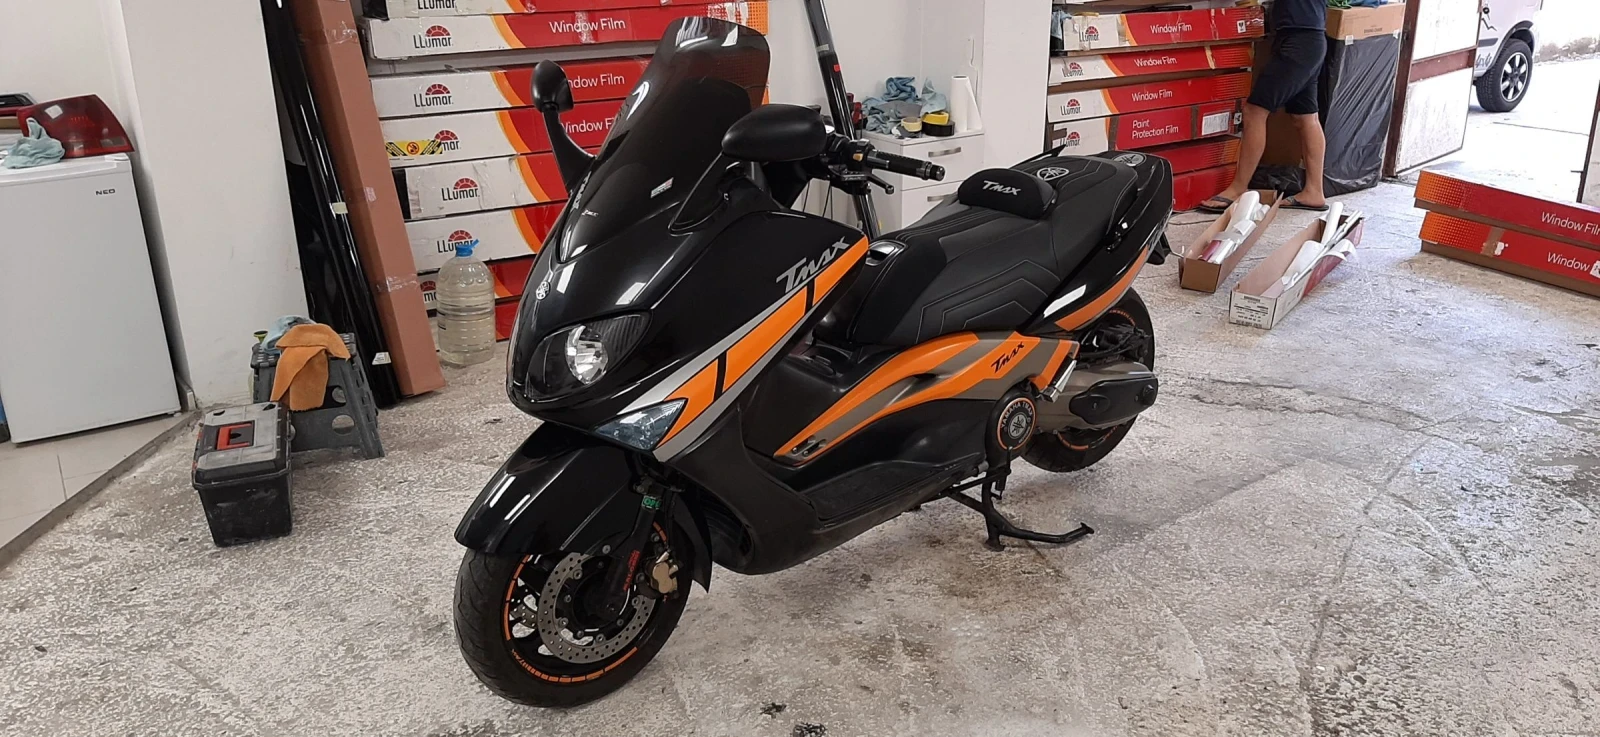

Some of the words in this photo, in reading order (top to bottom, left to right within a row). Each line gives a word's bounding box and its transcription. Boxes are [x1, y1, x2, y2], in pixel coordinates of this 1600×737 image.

[549, 20, 598, 33] Window
[600, 18, 626, 30] Film
[1150, 24, 1178, 34] Window
[1178, 23, 1193, 33] Film
[413, 34, 452, 49] LLumar
[1134, 57, 1161, 67] Window
[1162, 55, 1178, 65] Film
[568, 75, 598, 89] ndow
[600, 73, 625, 86] Film
[413, 92, 453, 108] LLumar
[1131, 90, 1158, 102] Window
[1158, 88, 1173, 99] Film
[1060, 105, 1081, 116] LLumar
[1132, 118, 1150, 129] Paint
[1131, 128, 1164, 140] Protection
[1165, 126, 1179, 137] Film
[441, 187, 480, 202] LLumar
[1541, 210, 1584, 231] Window
[1547, 251, 1590, 272] Window
[1001, 402, 1021, 429] YAMAHA
